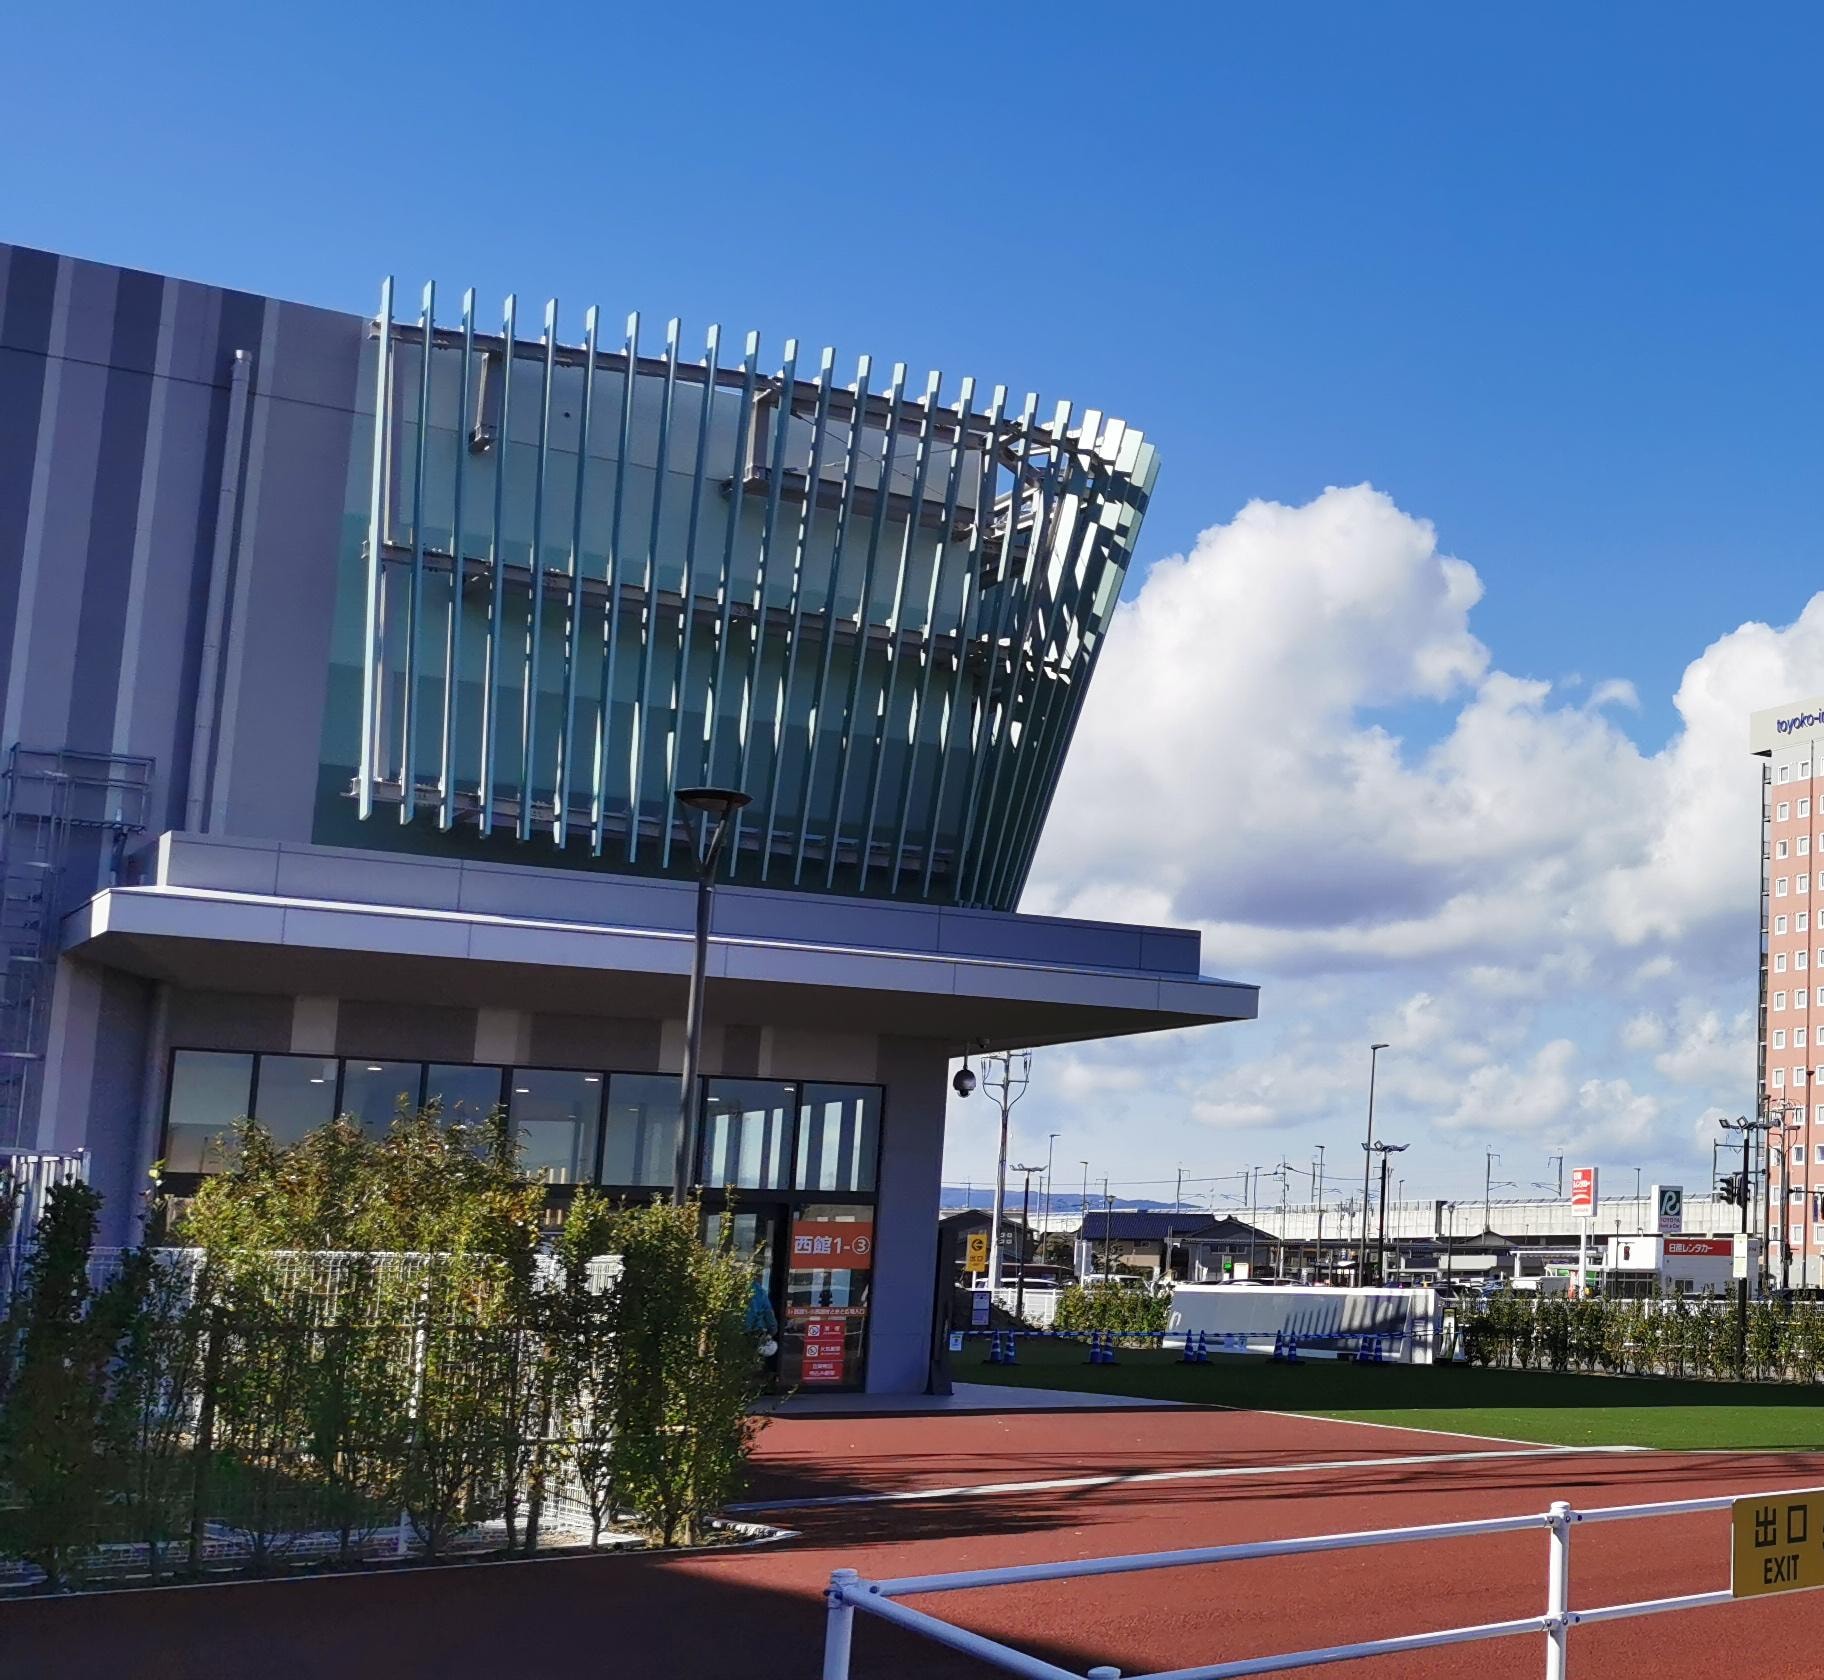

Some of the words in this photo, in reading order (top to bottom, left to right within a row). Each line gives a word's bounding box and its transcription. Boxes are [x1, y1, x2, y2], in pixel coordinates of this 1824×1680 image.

[1668, 1243, 1713, 1253] 日産レンタカー
[1754, 1504, 1808, 1549] 出口
[1763, 1554, 1800, 1585] EXIT
